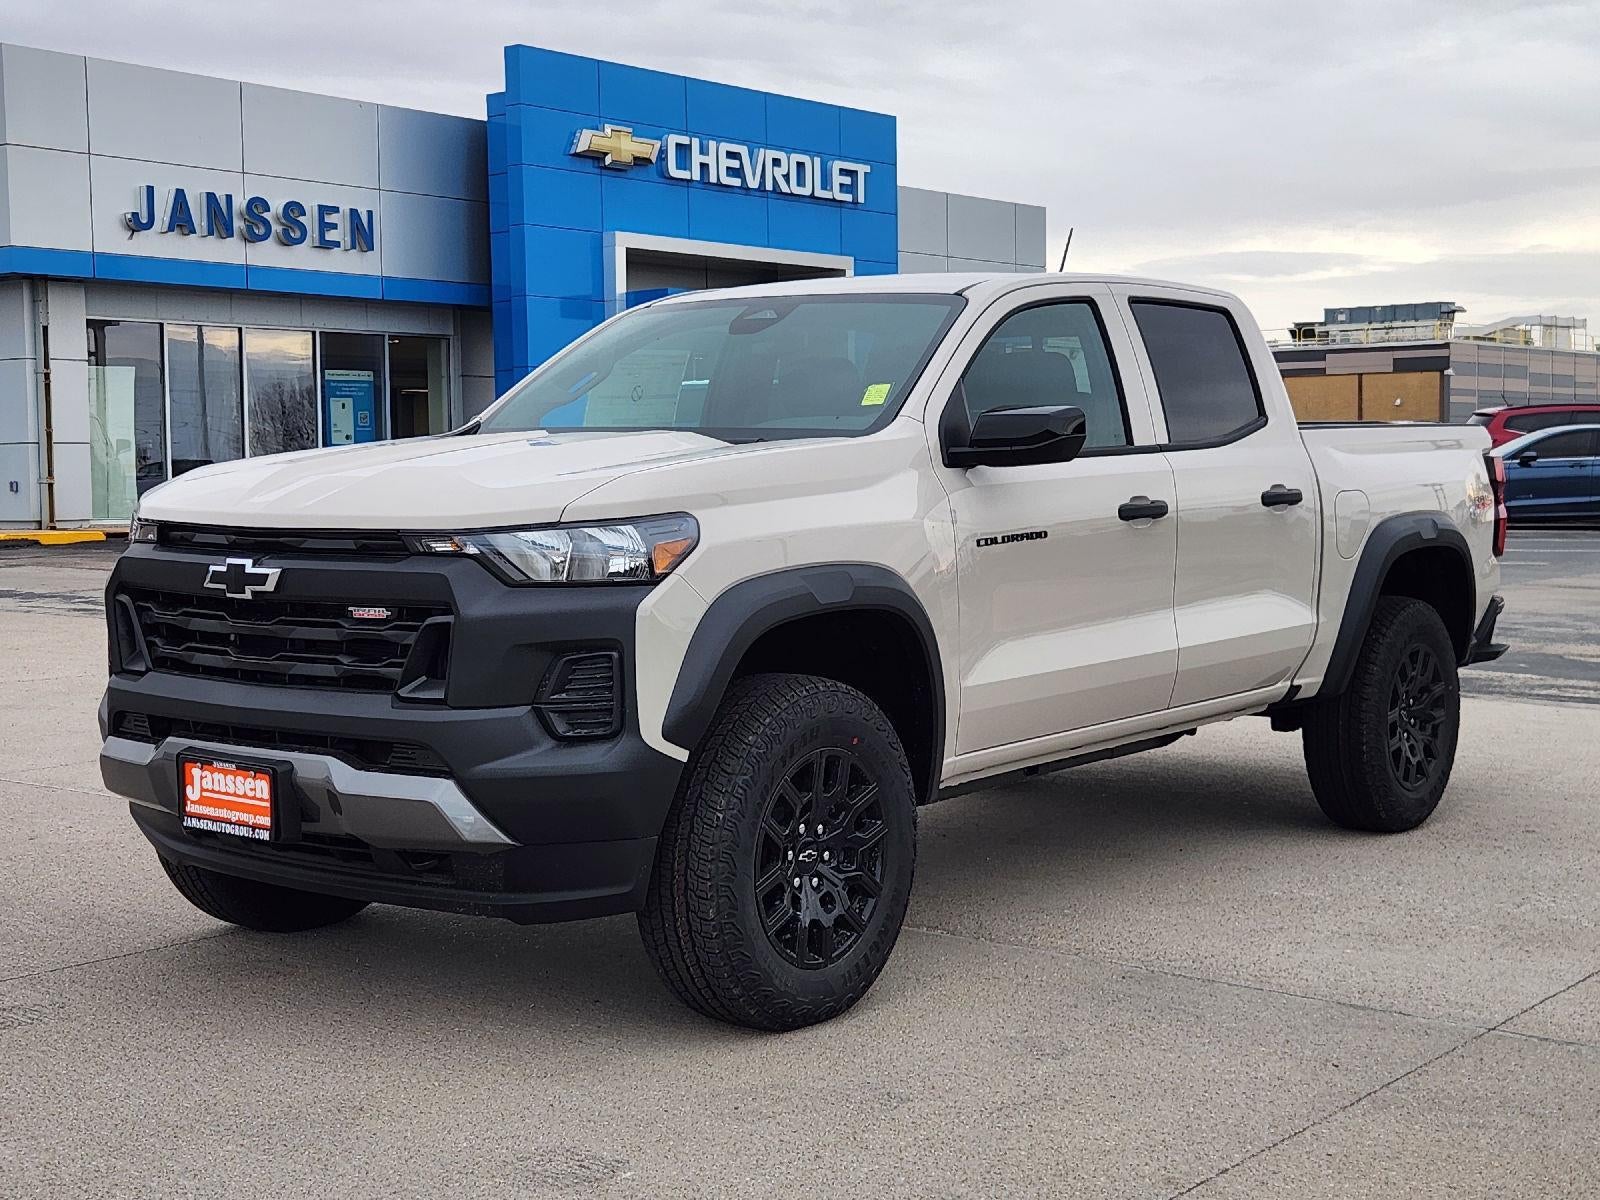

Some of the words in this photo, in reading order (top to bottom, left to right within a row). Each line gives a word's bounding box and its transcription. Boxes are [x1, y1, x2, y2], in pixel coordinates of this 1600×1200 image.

[662, 133, 871, 204] CHEVROLET
[124, 184, 375, 252] JANSSEN
[976, 530, 1048, 548] COLORADO
[185, 767, 270, 801] Janssen
[185, 800, 271, 827] Janssenautogroup.com
